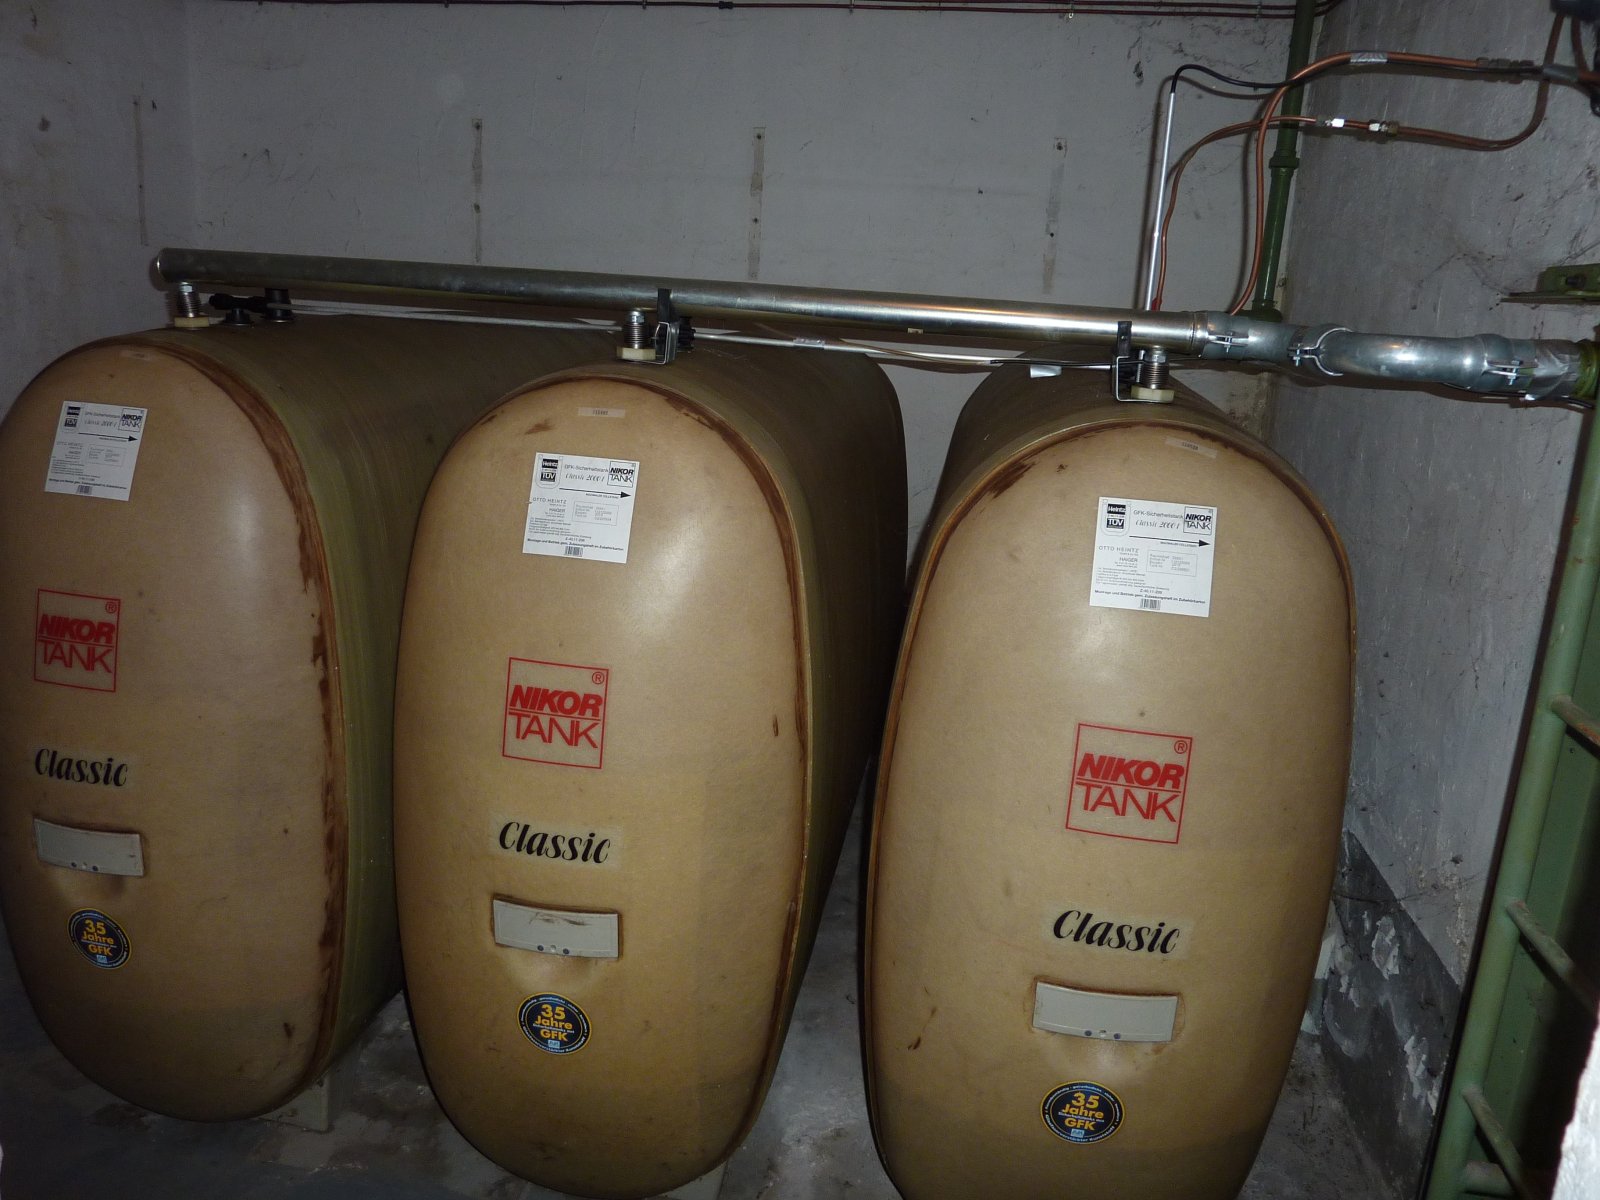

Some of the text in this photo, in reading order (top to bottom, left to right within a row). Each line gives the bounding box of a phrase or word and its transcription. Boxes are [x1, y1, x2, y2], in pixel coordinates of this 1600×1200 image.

[609, 474, 633, 483] TANK
[610, 467, 635, 476] NIKOR
[1185, 513, 1212, 522] NIKOR
[1185, 520, 1211, 530] TANK
[39, 613, 116, 645] NIKOR
[38, 639, 113, 674] TANK
[509, 684, 603, 718] NIKOR
[508, 711, 600, 749] TANK
[35, 748, 128, 787] Classic
[1077, 752, 1185, 789] NIKOR
[1076, 781, 1180, 822] TANK
[499, 821, 611, 864] Classic
[84, 919, 106, 935] 35
[1053, 909, 1181, 955] Classic
[82, 930, 114, 945] Jahre
[88, 944, 113, 956] GFK
[541, 1003, 566, 1020] 35
[535, 1015, 573, 1030] Jahre
[540, 1028, 568, 1042] GFK
[1071, 1091, 1100, 1109] 35
[1061, 1103, 1105, 1119] Jahre
[1064, 1117, 1096, 1131] GFK
